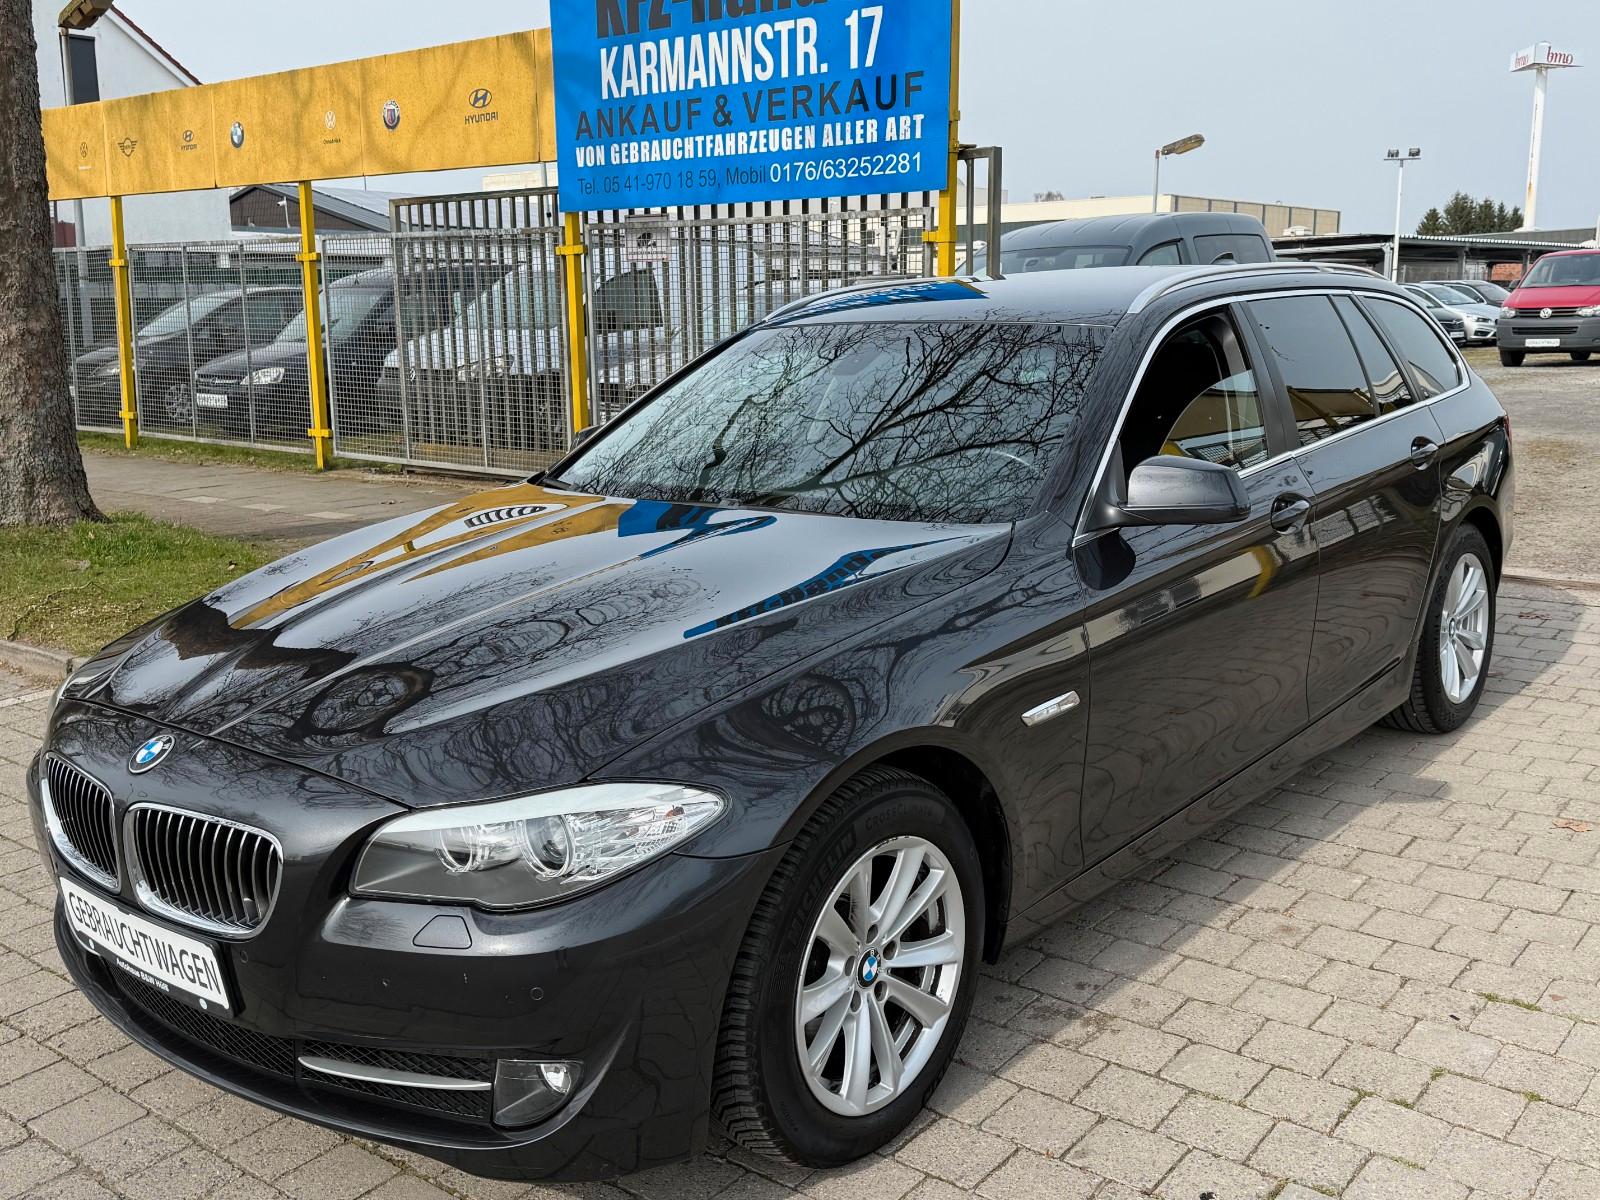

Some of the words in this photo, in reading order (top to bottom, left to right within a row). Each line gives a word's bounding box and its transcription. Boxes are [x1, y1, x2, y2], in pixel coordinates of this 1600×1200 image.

[600, 17, 829, 100] KARMANNSTR.
[844, 5, 884, 70] 17
[464, 111, 499, 125] HYUNDAI
[575, 97, 702, 141] ANKAUF
[712, 94, 733, 128] &
[742, 70, 925, 123] VERKAUF
[575, 144, 606, 168] VON
[610, 124, 816, 165] GEBRAUCHTFAHRZEUGEN
[822, 118, 878, 147] ALLER
[885, 113, 925, 141] ART
[577, 178, 599, 195] Tel.
[603, 176, 620, 193] 05
[624, 172, 671, 192] 41-970
[677, 170, 694, 189] 18
[698, 168, 721, 189] 59,
[725, 165, 766, 186] Mobil
[769, 151, 921, 183] 0176/63252281
[68, 891, 222, 996] GEBRAUCHTWAGEN
